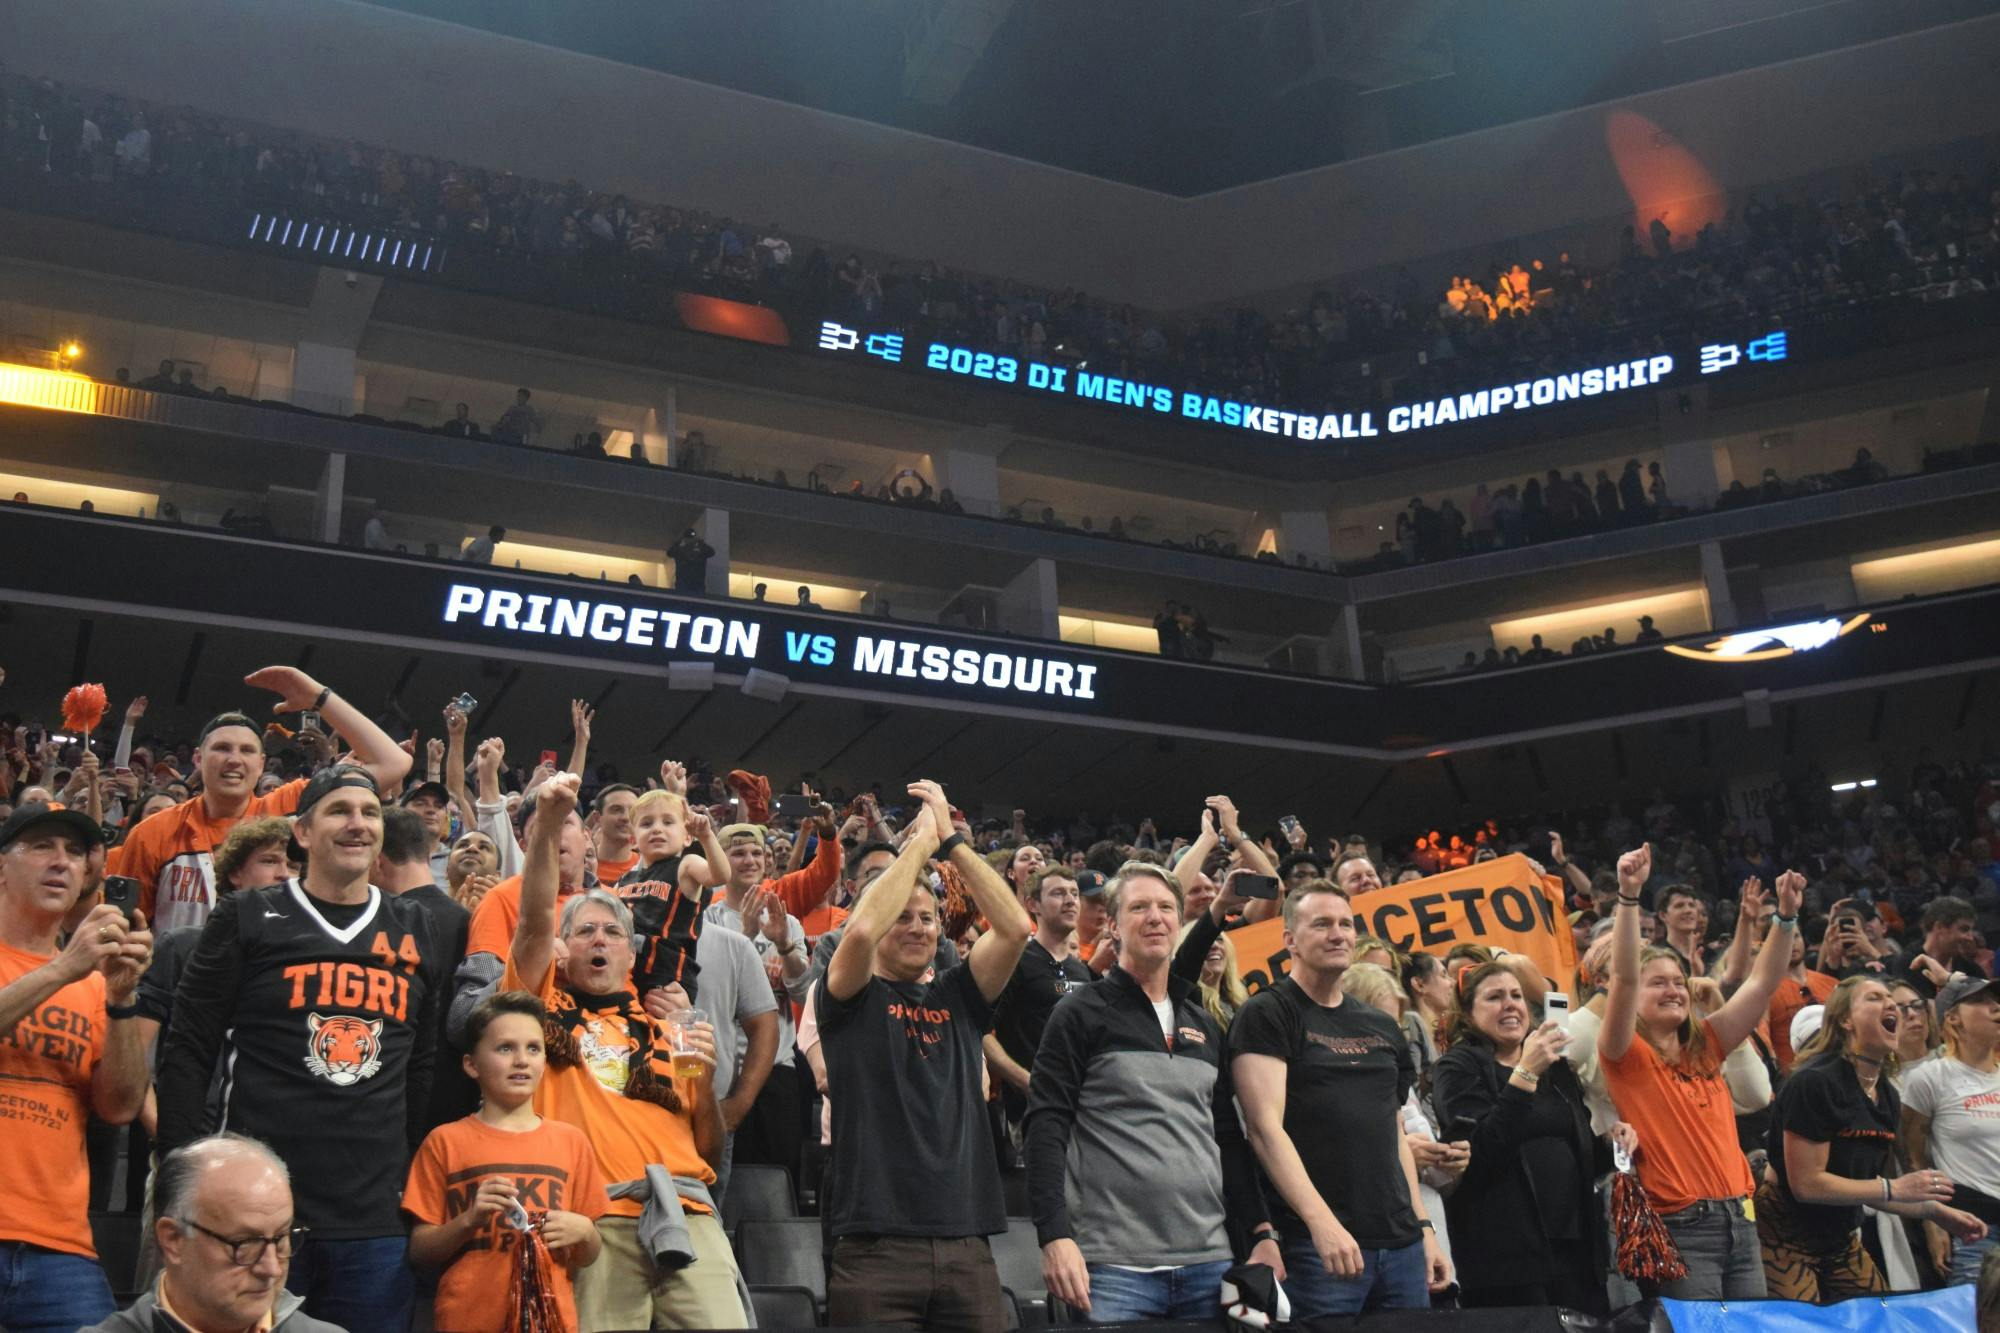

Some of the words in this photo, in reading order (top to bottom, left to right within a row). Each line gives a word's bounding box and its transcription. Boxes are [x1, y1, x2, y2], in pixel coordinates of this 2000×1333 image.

[927, 344, 1018, 383] 2023
[1028, 362, 1067, 393] DI
[1076, 372, 1172, 413] MEN'S
[1182, 393, 1378, 441] BASKETBALL
[1388, 355, 1673, 433] CHAMPIONSHIP
[443, 584, 761, 659] PRINCETON
[786, 631, 836, 666] VS
[853, 636, 1097, 699] MISSOURI
[371, 931, 421, 975] 44
[283, 962, 409, 1022] TIGRI
[447, 1177, 562, 1221] MKE
